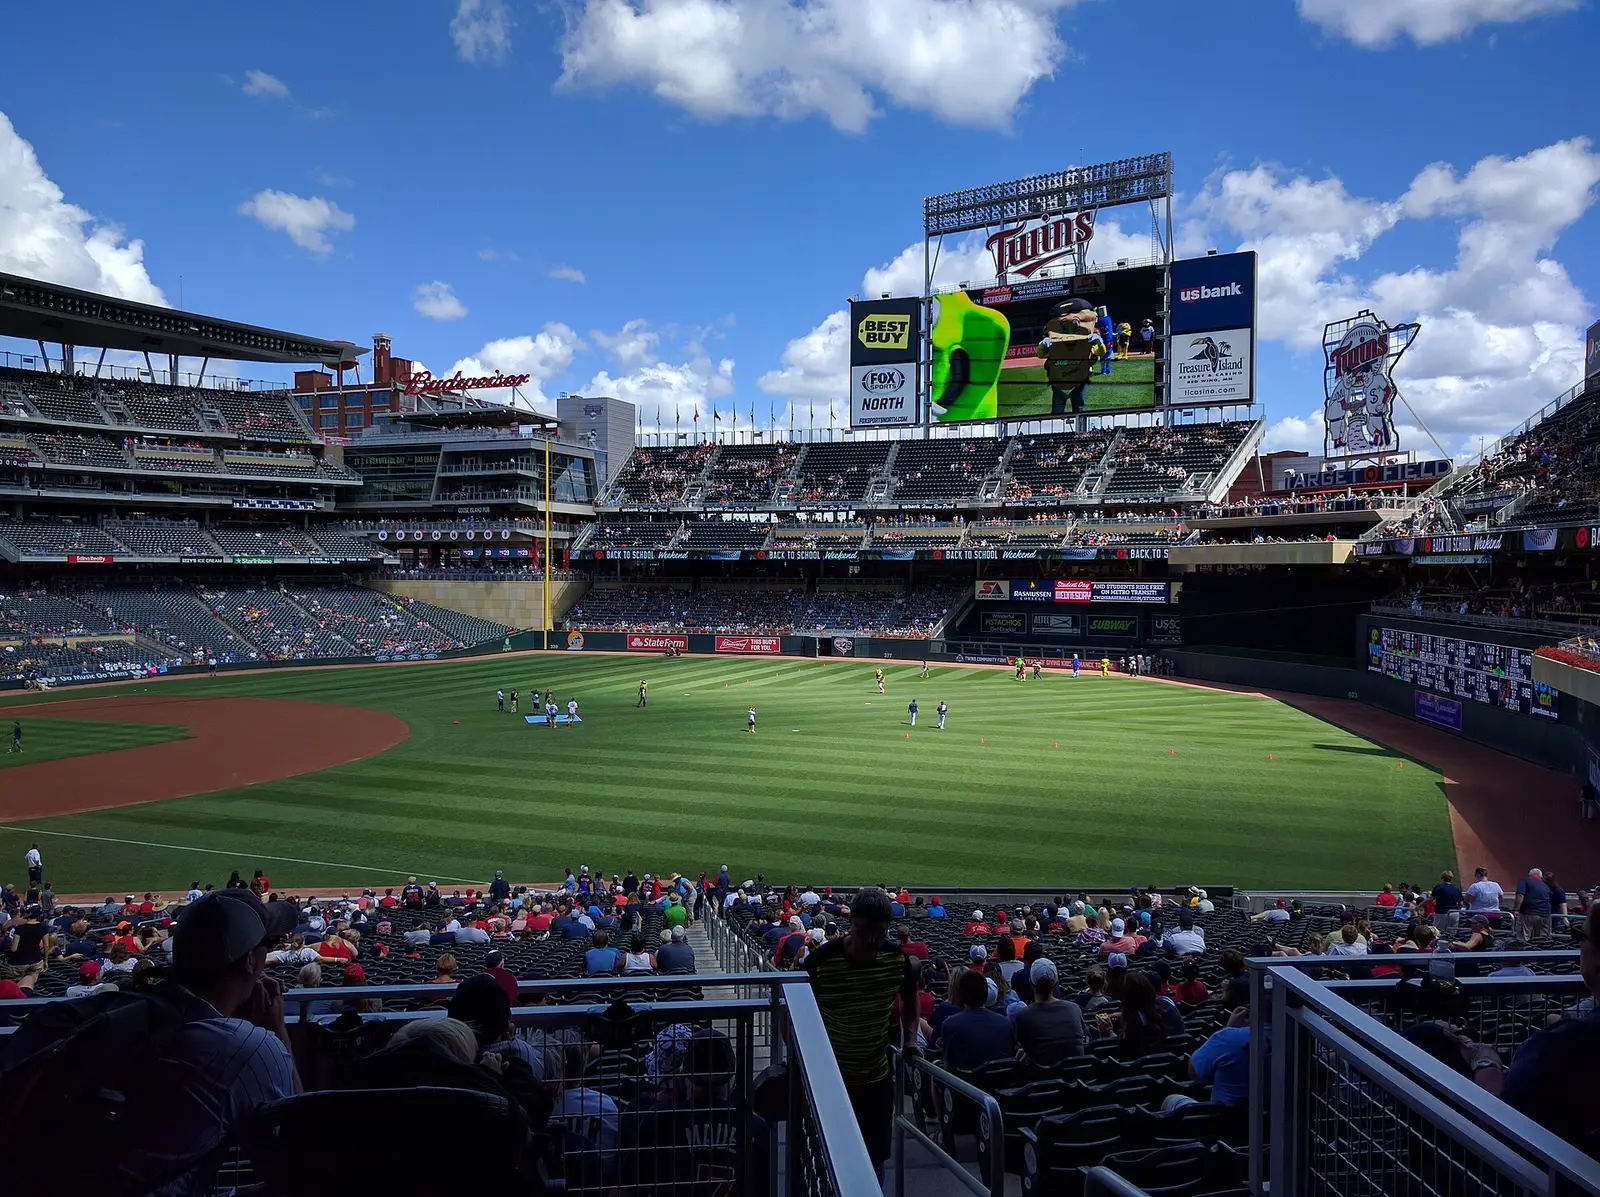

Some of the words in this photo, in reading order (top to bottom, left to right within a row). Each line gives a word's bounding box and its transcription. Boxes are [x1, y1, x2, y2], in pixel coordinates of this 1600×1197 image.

[986, 211, 1094, 278] Twins
[865, 320, 909, 332] BEST
[866, 332, 904, 344] BUY
[1330, 333, 1389, 380] Twins
[1178, 362, 1211, 375] Treasure
[1219, 357, 1244, 371] Island
[399, 370, 530, 396] Budweiser
[870, 371, 896, 385] FOX
[1184, 386, 1236, 396] ticasino.com
[1370, 388, 1378, 404] S
[862, 396, 904, 411] NORTH
[414, 455, 439, 463] BASEBALL
[1284, 470, 1355, 489] TARGET
[1383, 459, 1452, 480] FIELD
[1432, 538, 1444, 552] BACK
[1445, 537, 1451, 551] TO
[1453, 536, 1471, 551] SCHOOL
[1474, 535, 1502, 550] Weekend
[606, 551, 622, 559] BACK
[623, 551, 630, 559] TO
[632, 551, 654, 559] SCHOOL
[657, 551, 688, 560] Weekend
[769, 551, 785, 560] BACK
[787, 551, 795, 560] TO
[797, 551, 820, 560] SCHOOL
[824, 551, 858, 560] Weekend
[945, 550, 962, 560] BACK
[964, 550, 972, 560] TO
[974, 550, 998, 560] SCHOOL
[1002, 550, 1037, 559] Weekend
[1130, 549, 1150, 559] BACK
[1151, 549, 1161, 559] TO
[1079, 581, 1090, 589] Day
[1014, 591, 1052, 599] RASMUSSEN
[1055, 590, 1091, 600] WEDNESDAY
[985, 618, 1021, 626] PISTACHIOS
[1090, 619, 1132, 630] SUBWAY
